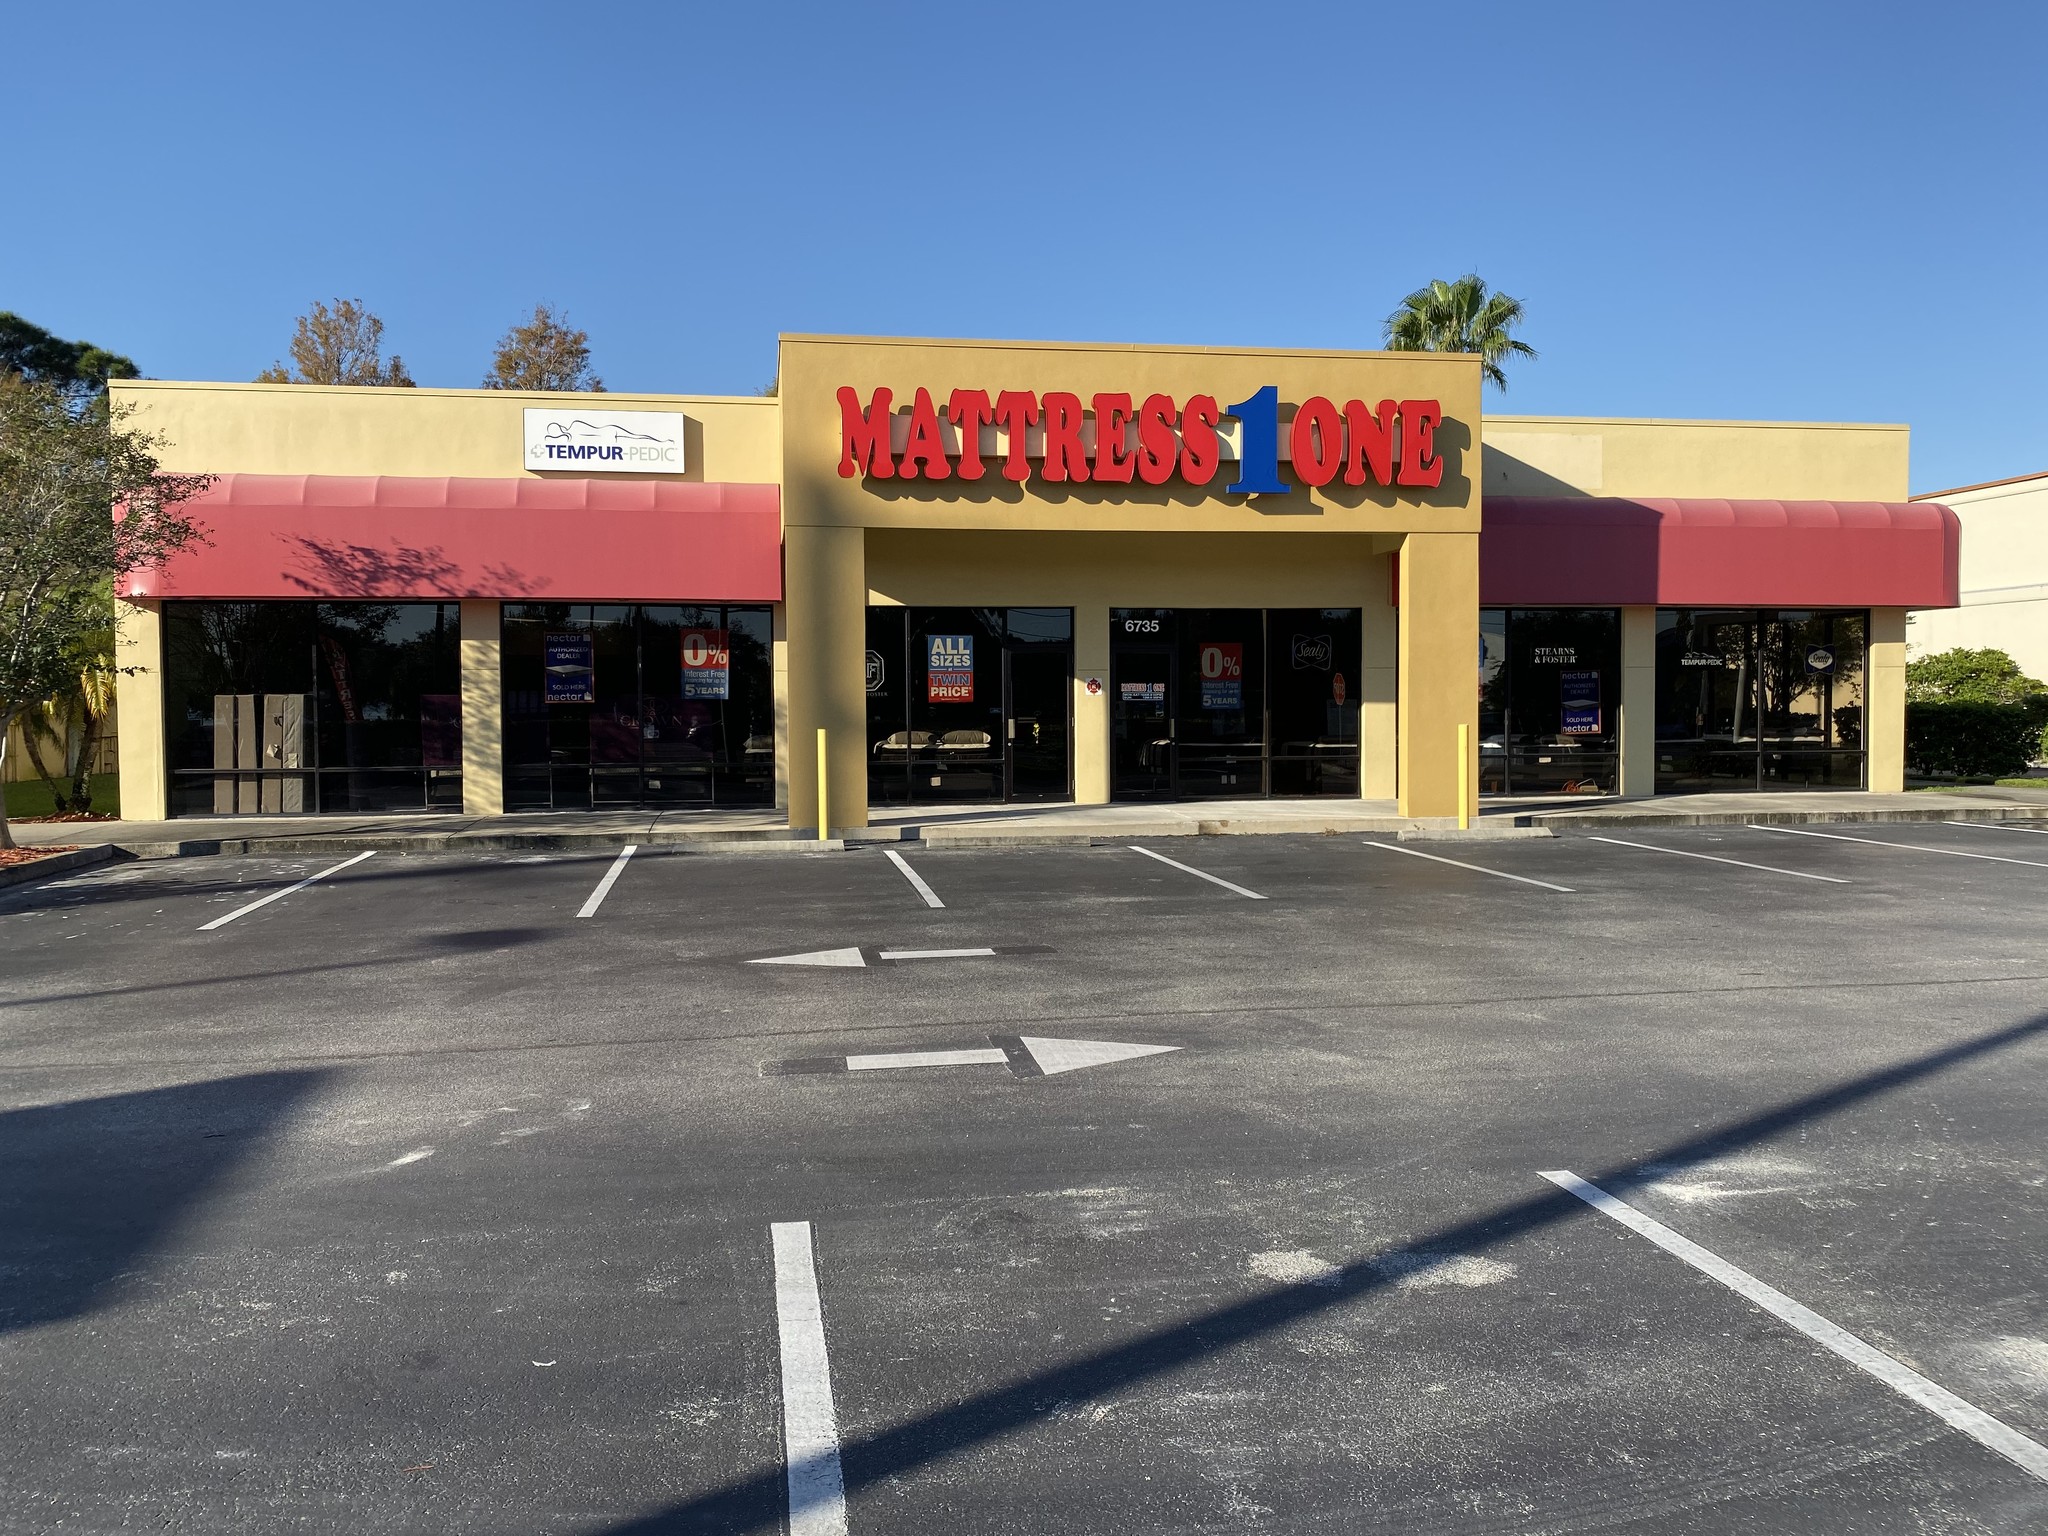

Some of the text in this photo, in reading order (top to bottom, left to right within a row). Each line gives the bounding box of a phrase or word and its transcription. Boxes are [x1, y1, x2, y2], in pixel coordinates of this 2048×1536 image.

[836, 385, 1444, 495] MATTRESS 1 ONE
[545, 444, 676, 462] TEMPUR-PEDIC
[1125, 620, 1160, 632] 6735
[546, 634, 582, 642] nectar
[683, 633, 727, 667] 0%
[931, 638, 970, 655] ALL
[1297, 643, 1326, 660] Sealy
[1534, 647, 1575, 656] STEARNS
[930, 655, 971, 667] SIZES
[1201, 647, 1241, 678] 0%
[1534, 656, 1577, 664] & FOSTER
[1681, 658, 1723, 666] TEMPUR-PEDIC
[1810, 652, 1831, 664] Sealy
[685, 670, 726, 678] Interest Free
[930, 673, 971, 686] TWIN
[1562, 671, 1591, 680] nectar
[685, 684, 696, 696] 5
[547, 693, 582, 701] nectar
[1202, 694, 1238, 707] 5 YEARS
[1562, 724, 1591, 732] nectar
